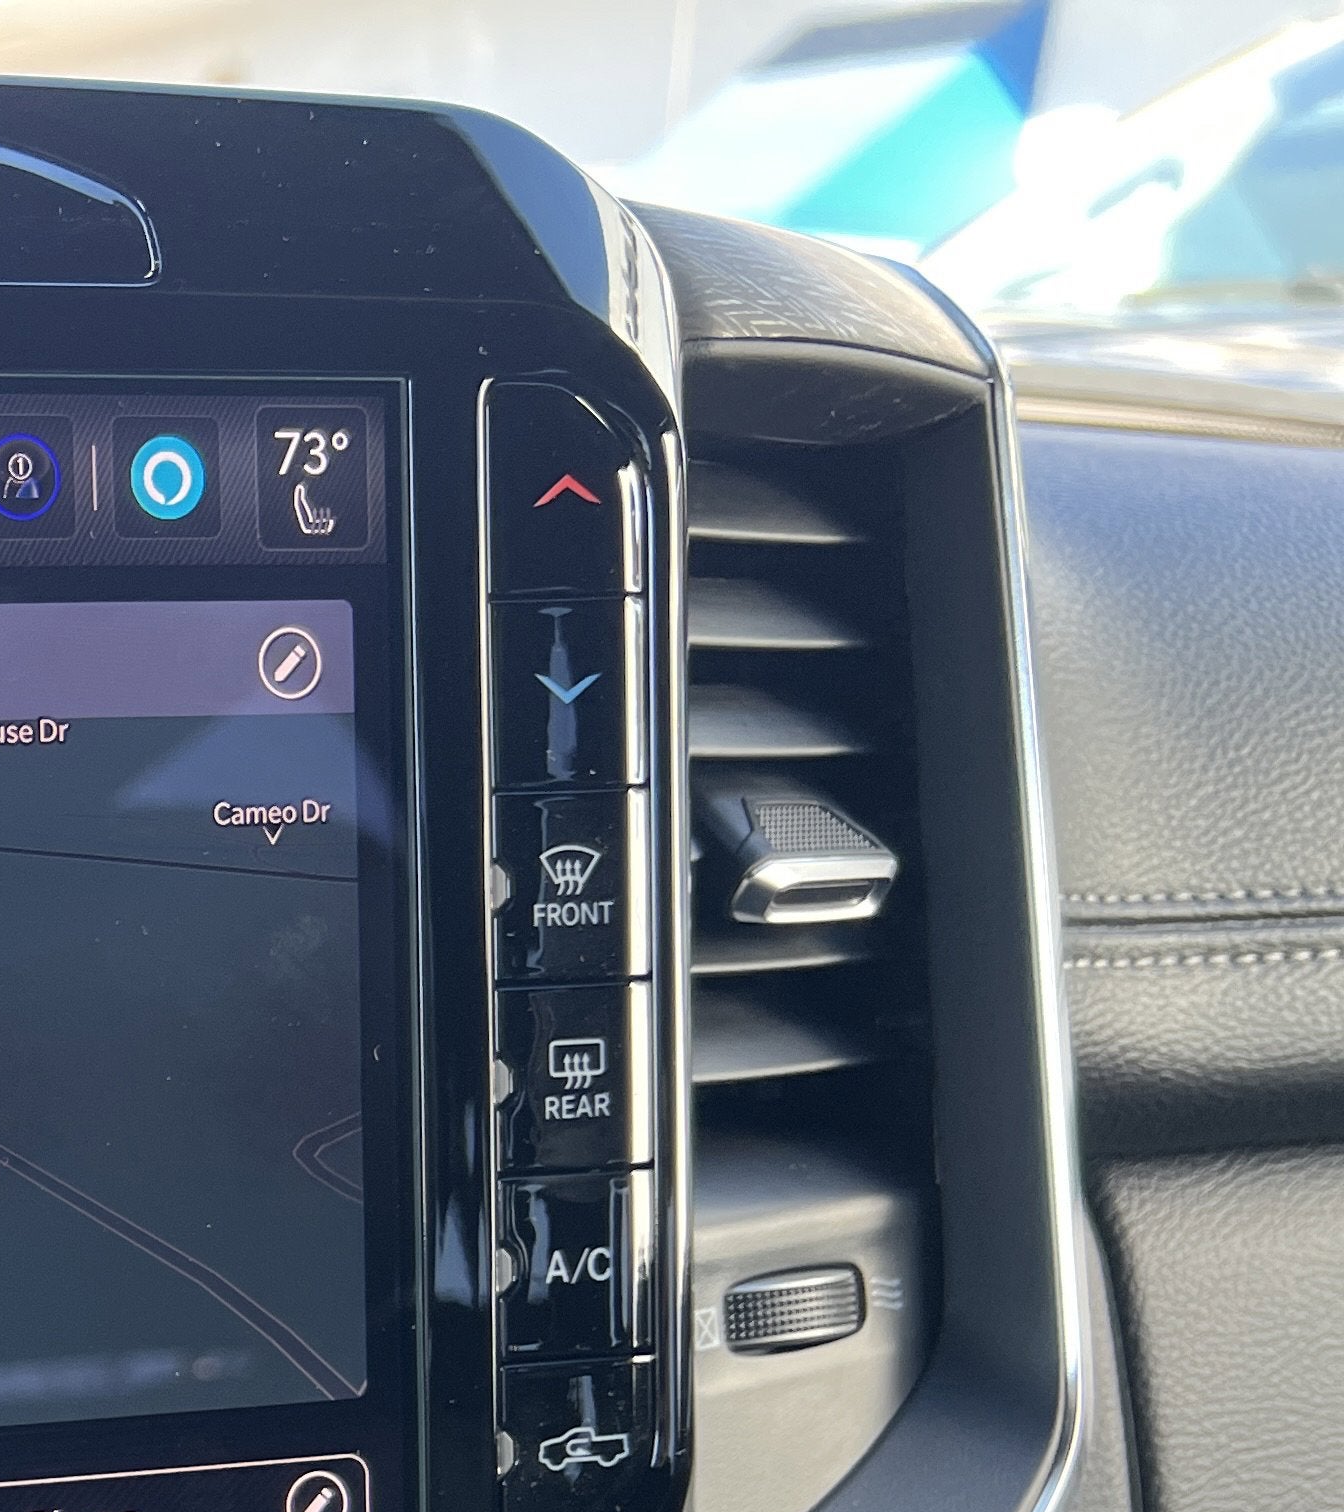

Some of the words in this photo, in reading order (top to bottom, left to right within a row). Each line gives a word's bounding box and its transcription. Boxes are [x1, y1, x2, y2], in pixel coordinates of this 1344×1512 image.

[273, 430, 350, 475] 73°
[39, 719, 69, 743] Dr
[213, 802, 297, 826] Cameo
[302, 800, 331, 823] Dr
[533, 901, 613, 927] FRONT
[545, 1094, 610, 1120] REAR
[545, 1247, 612, 1283] A/C
